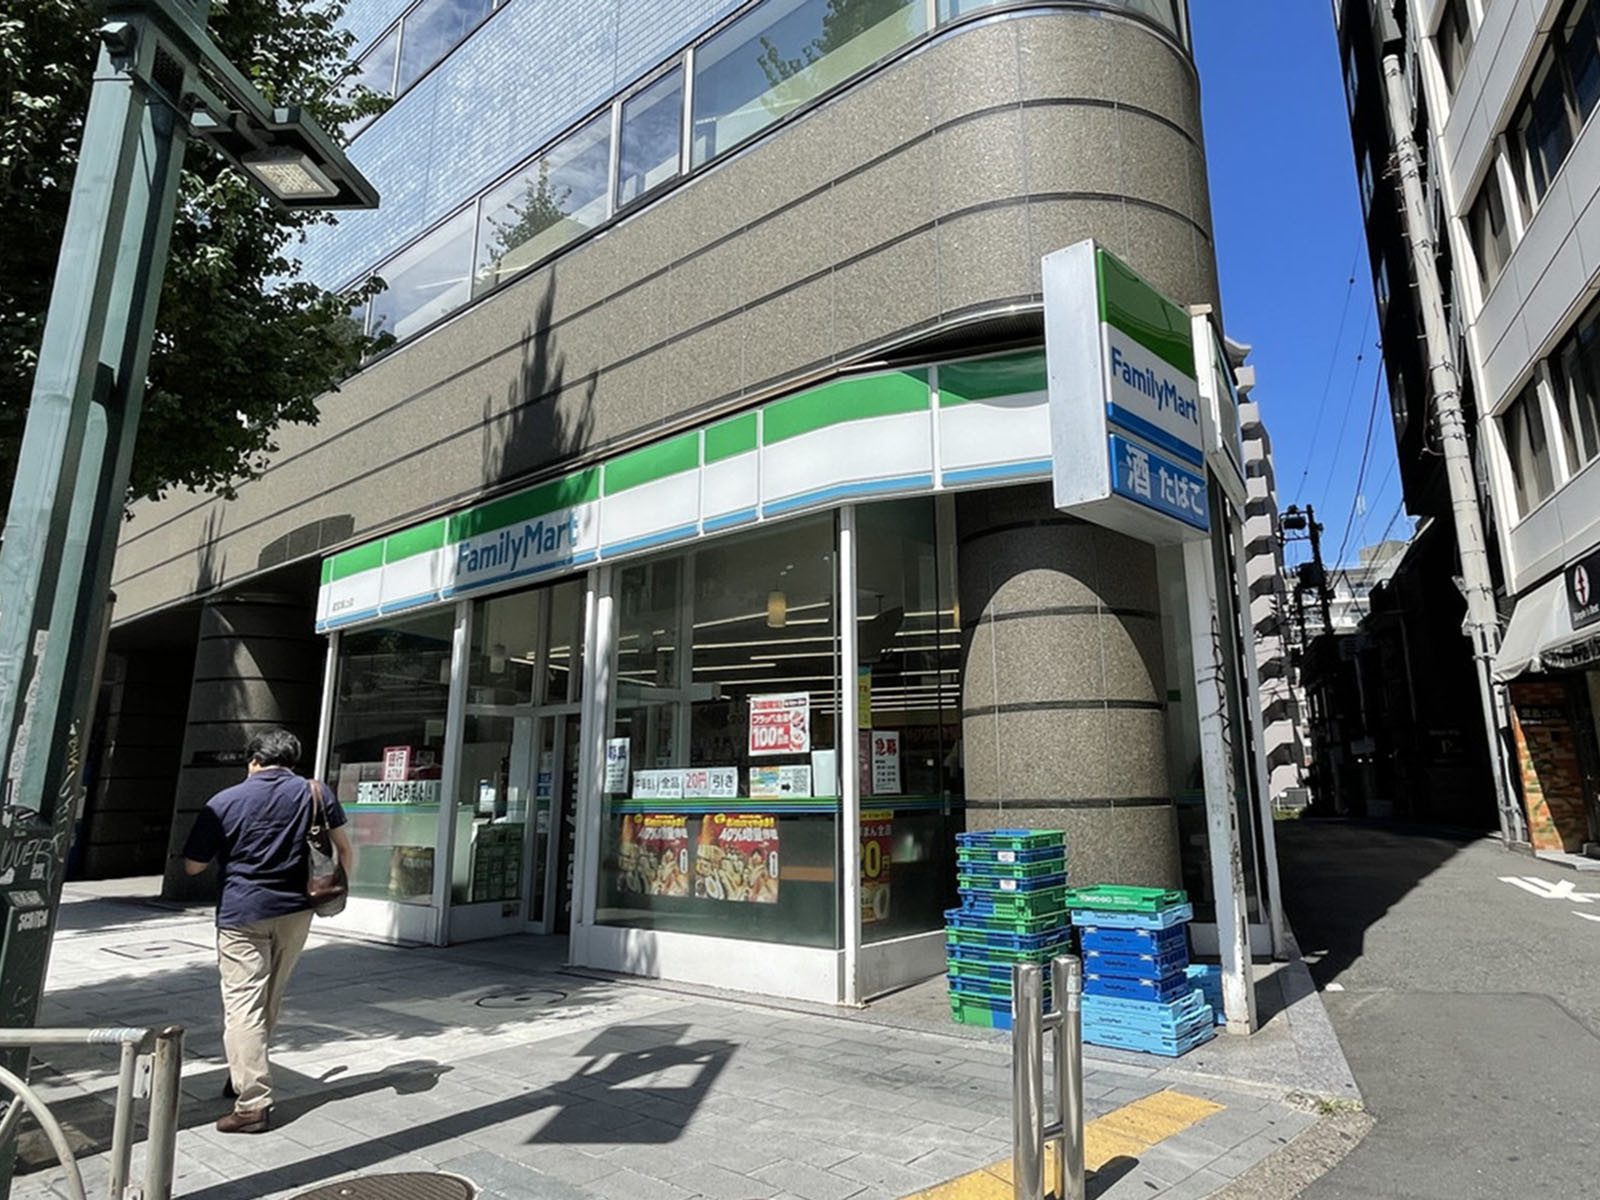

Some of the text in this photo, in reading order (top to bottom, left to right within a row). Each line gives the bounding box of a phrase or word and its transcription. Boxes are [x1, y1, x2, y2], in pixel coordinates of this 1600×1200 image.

[1111, 346, 1197, 424] FamilyMart
[1125, 443, 1204, 515] 酒 たばこ
[456, 511, 578, 575] FamilyMart
